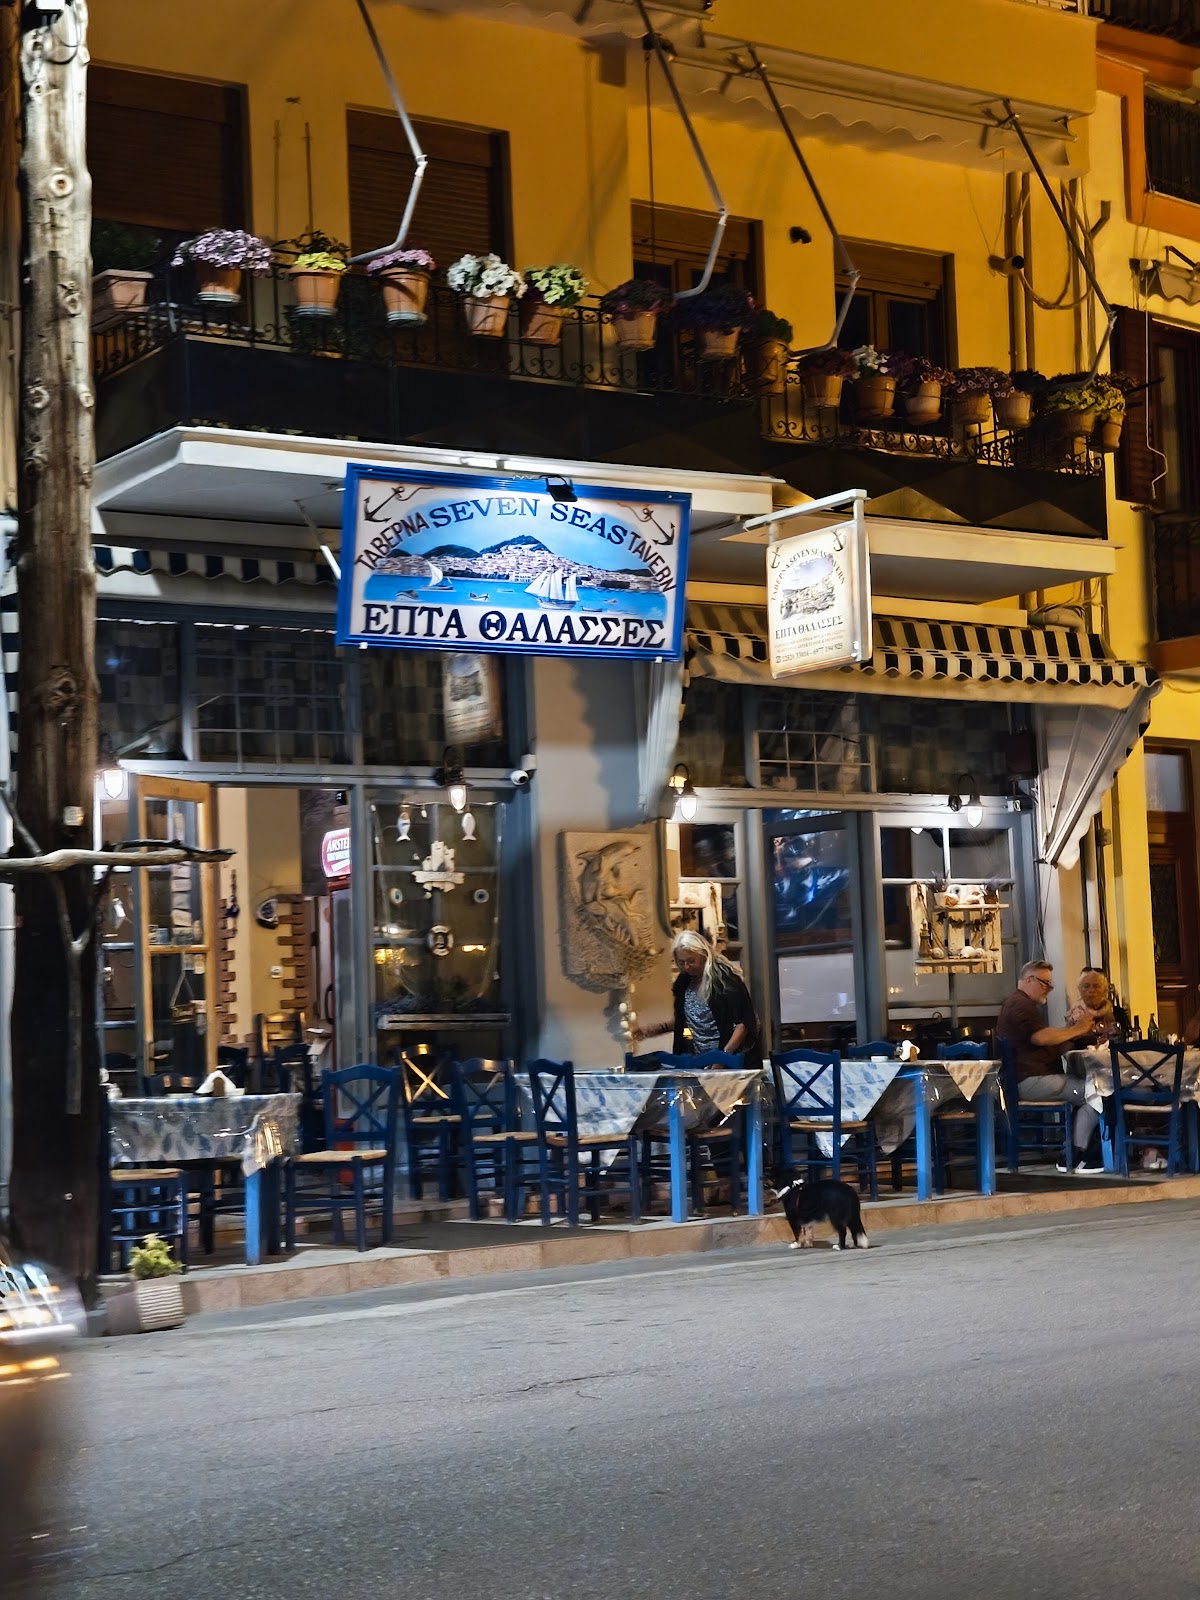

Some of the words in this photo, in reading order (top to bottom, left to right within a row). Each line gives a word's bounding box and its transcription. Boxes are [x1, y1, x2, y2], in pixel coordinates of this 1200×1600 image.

[355, 512, 430, 571] ΤΑΒΕΡΝΑ
[429, 497, 540, 528] SEVEN
[550, 502, 628, 545] SEAS
[627, 532, 677, 593] TAVERN
[789, 549, 810, 566] SEVEN
[362, 604, 467, 639] ΕΠΤΑ
[479, 611, 666, 648] ΘΑΛΑΣΣΕΣ
[775, 626, 798, 640] ΕΠΤΑ
[798, 615, 844, 634] ΘΑΛΑΣΣΕΣ
[327, 837, 350, 852] AMSTE
